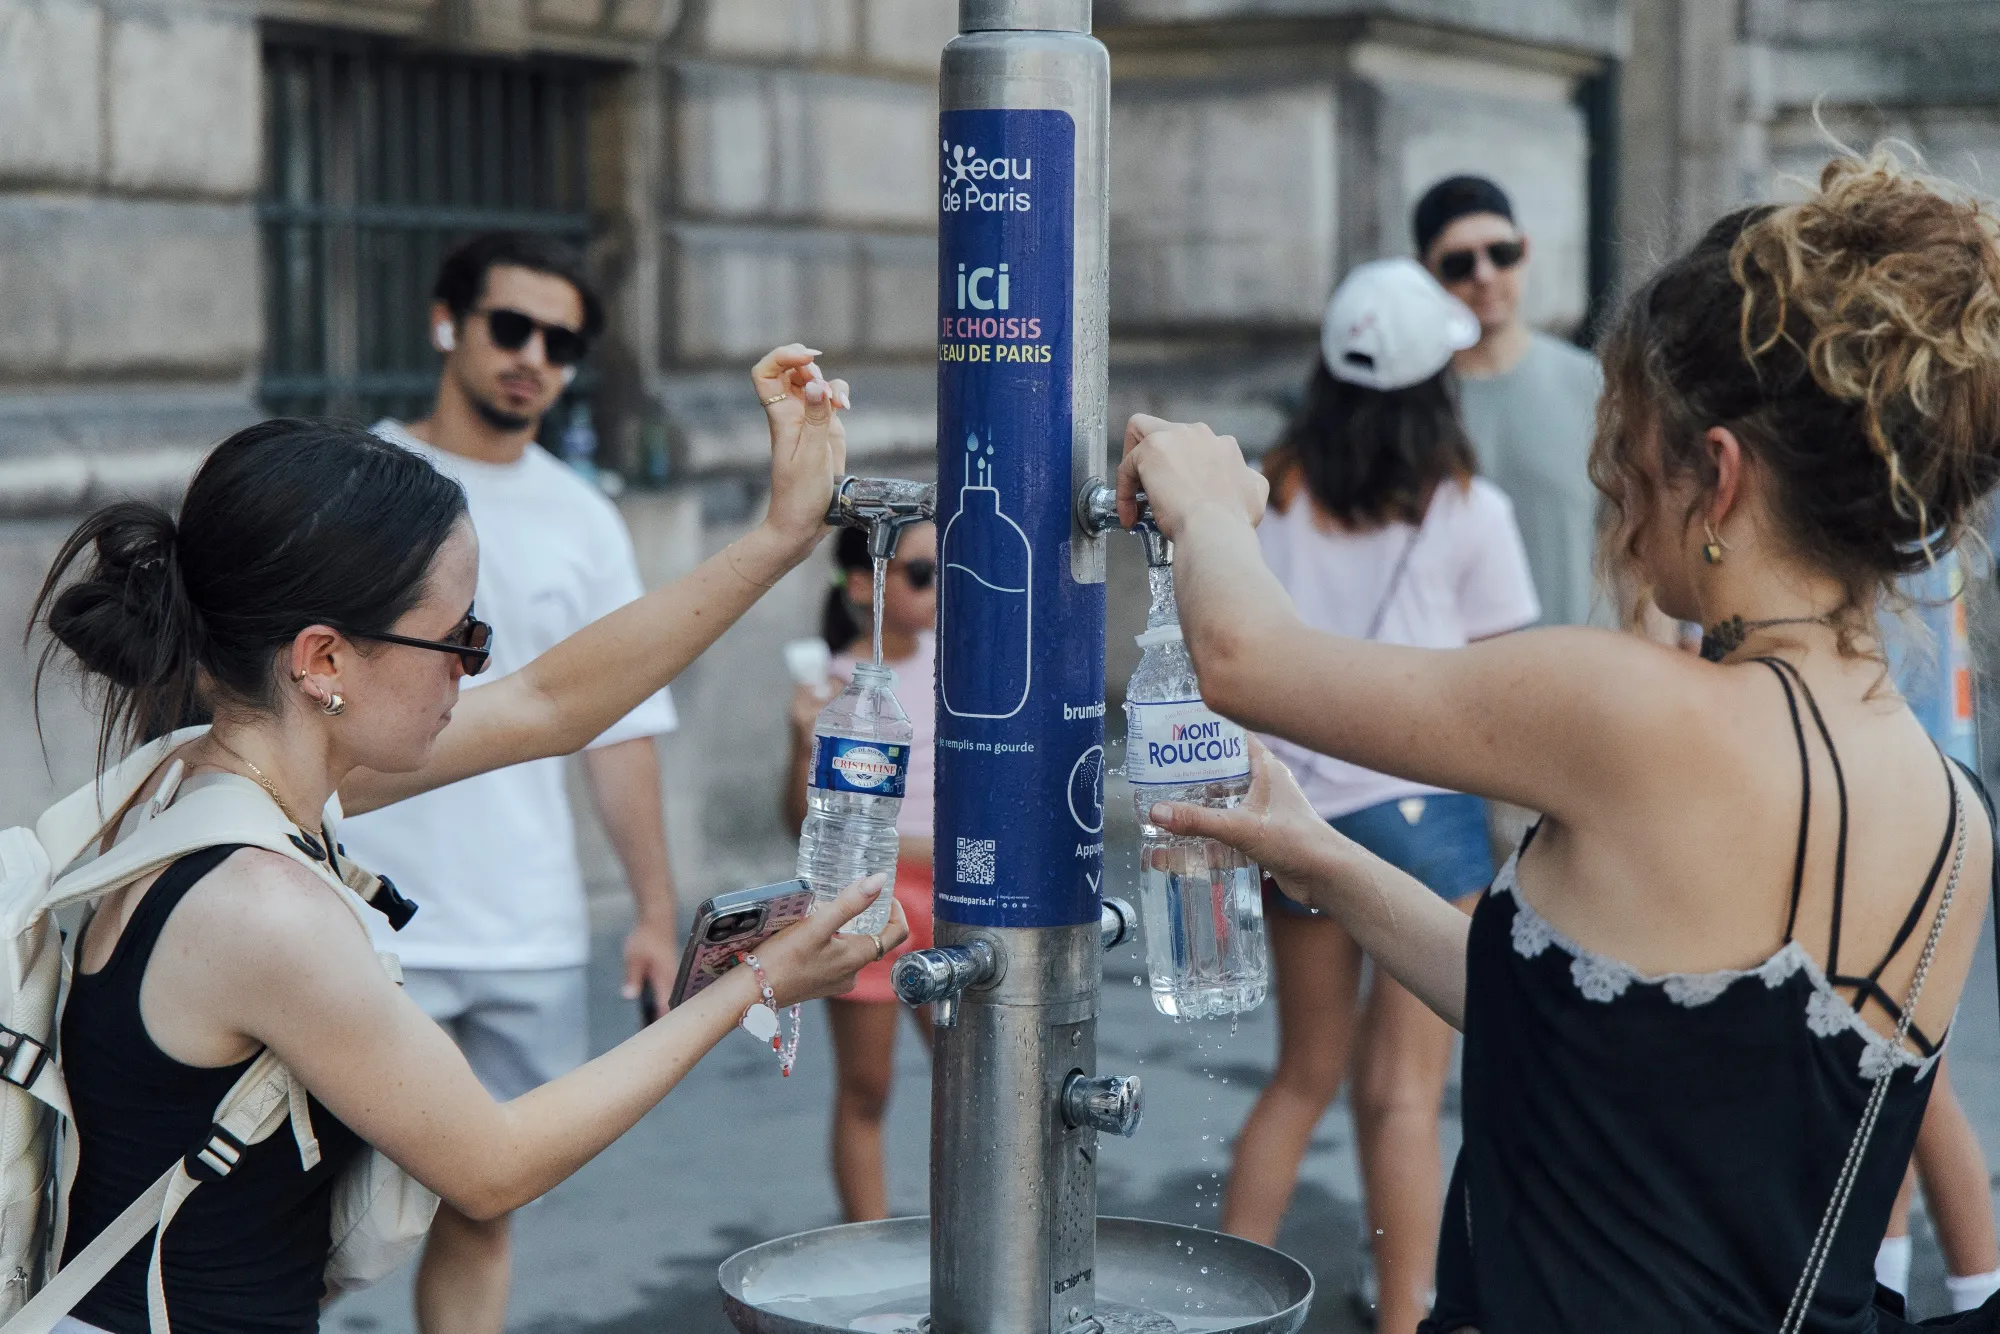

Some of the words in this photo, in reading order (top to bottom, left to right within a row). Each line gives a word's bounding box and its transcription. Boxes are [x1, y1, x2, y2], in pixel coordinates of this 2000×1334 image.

[942, 187, 961, 212] de
[965, 187, 1031, 212] Paris
[968, 344, 991, 362] DE
[1172, 721, 1220, 741] MONT
[945, 739, 974, 752] remplis
[976, 743, 992, 752] ma
[994, 741, 1035, 755] gourde
[1148, 736, 1241, 768] ROUCOUS
[833, 758, 896, 775] CRISTALINE
[938, 892, 996, 906] www.eaudeparis.fr
